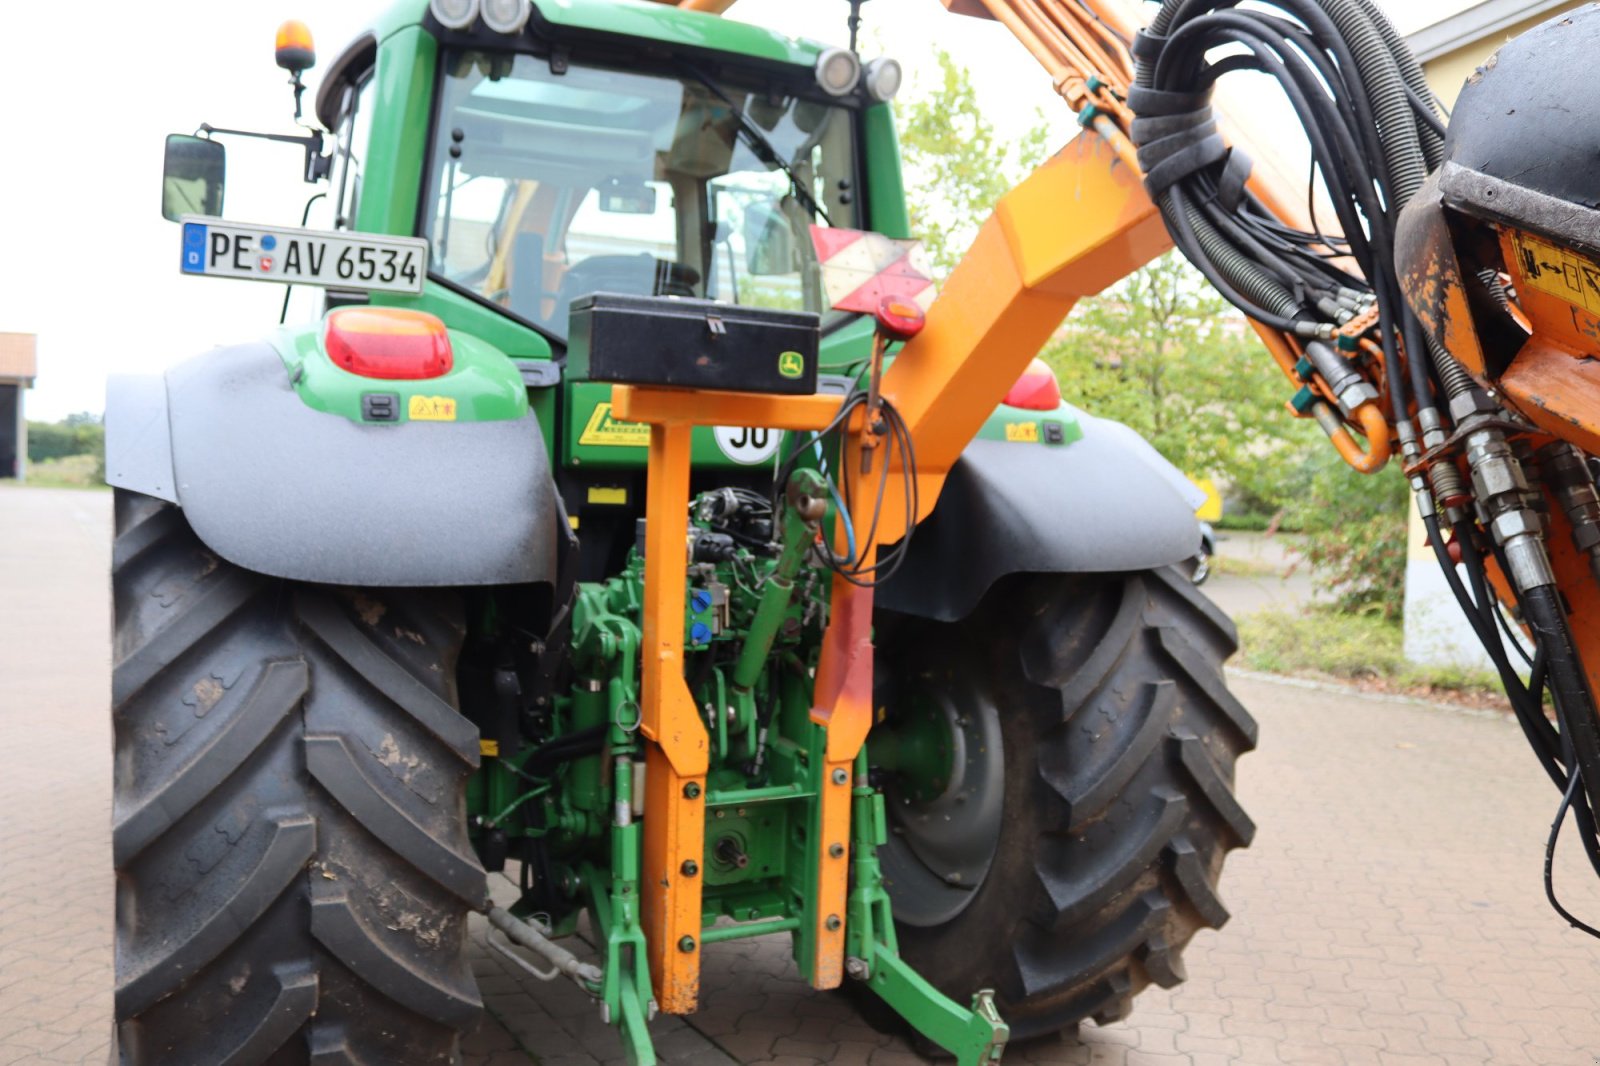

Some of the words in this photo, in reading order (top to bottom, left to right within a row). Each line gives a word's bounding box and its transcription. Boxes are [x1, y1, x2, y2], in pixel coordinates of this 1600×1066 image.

[188, 251, 199, 265] D
[210, 232, 253, 270] PE
[283, 240, 326, 276] AV
[337, 246, 417, 285] 6534
